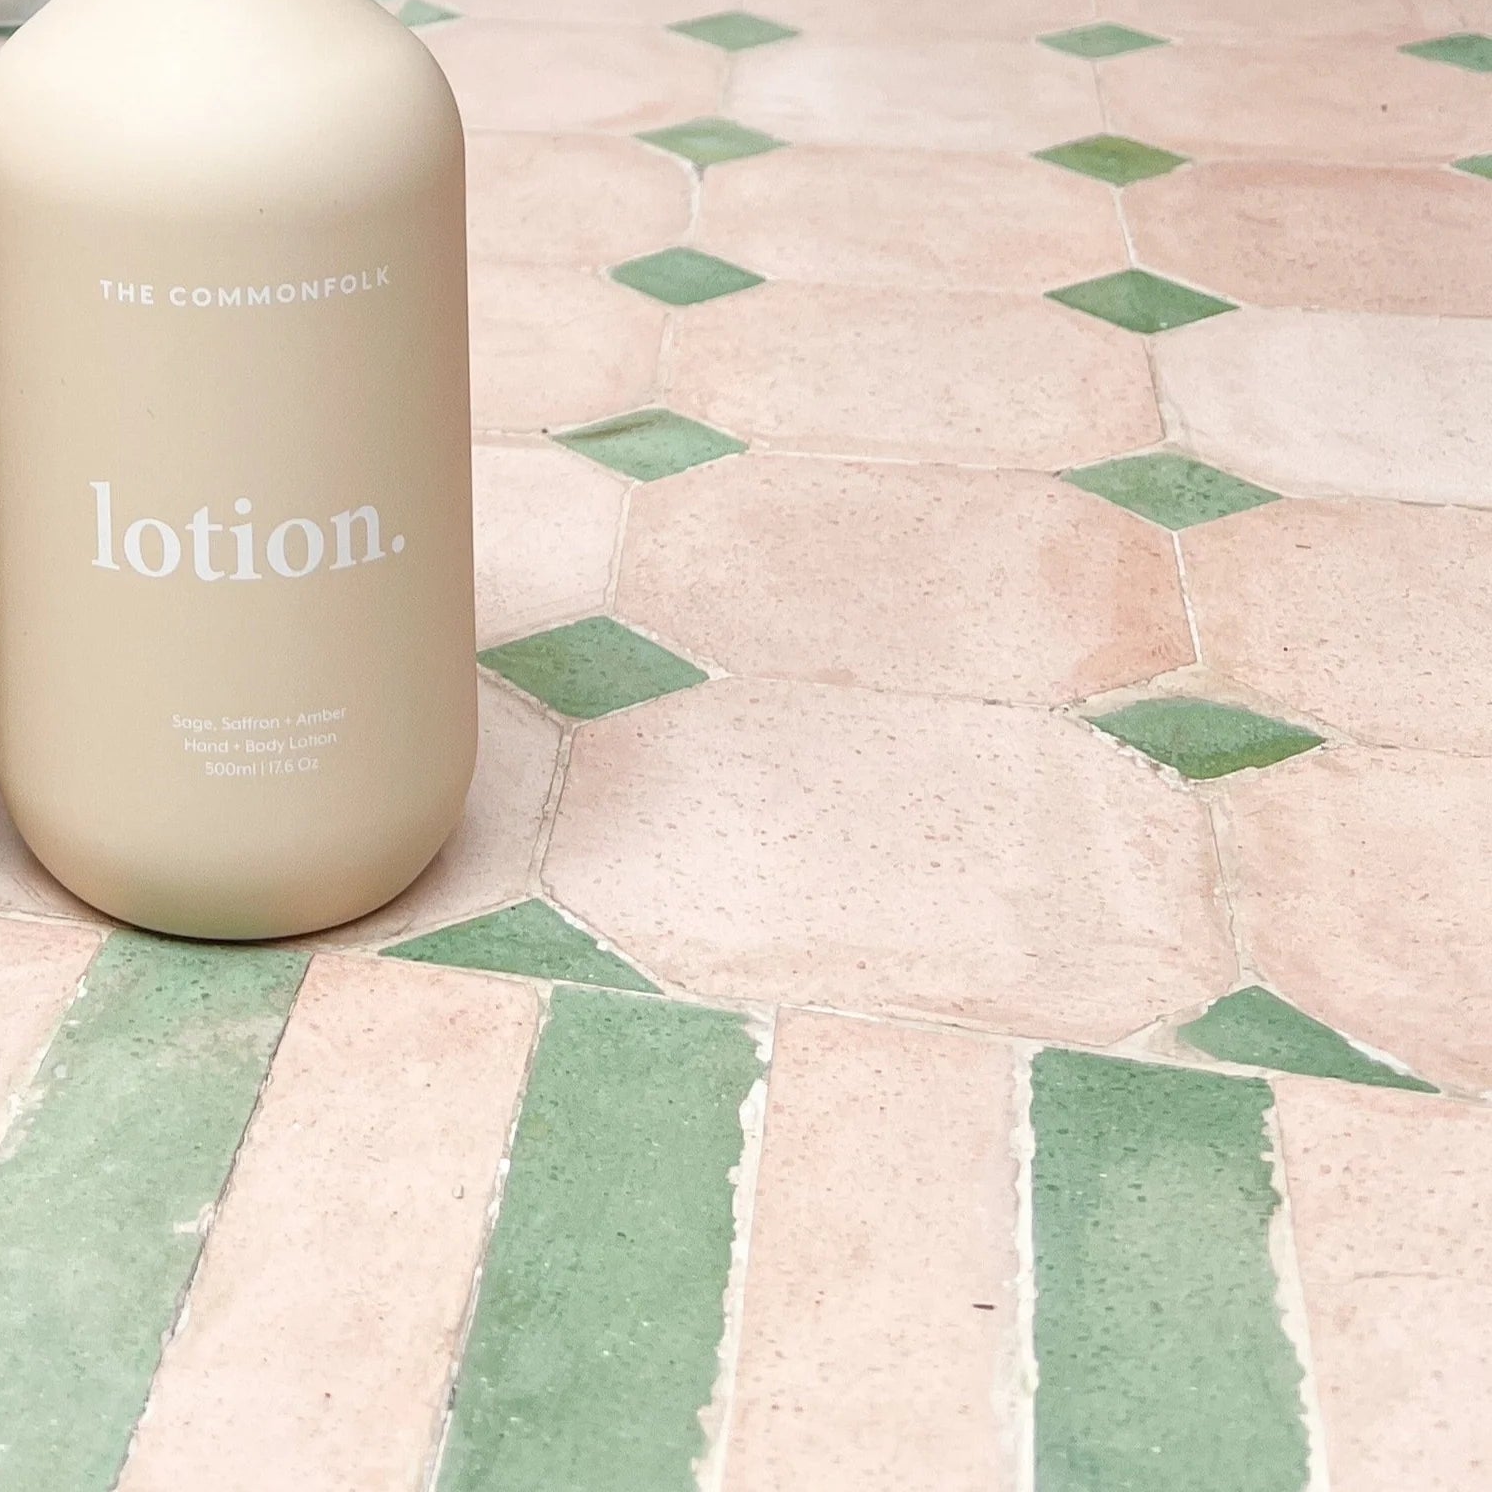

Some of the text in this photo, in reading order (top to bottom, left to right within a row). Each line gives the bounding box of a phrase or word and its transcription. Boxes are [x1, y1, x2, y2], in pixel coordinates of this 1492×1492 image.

[100, 265, 390, 307] THE COMMONFOLK
[89, 481, 405, 582] lotion.
[172, 714, 217, 732] Sage,
[222, 716, 280, 731] Saffron
[296, 707, 347, 726] Amber
[184, 738, 229, 753] Hand
[245, 739, 285, 754] Body
[290, 732, 337, 750] Lotion
[205, 761, 256, 776] 500ml
[298, 756, 318, 771] Oz
